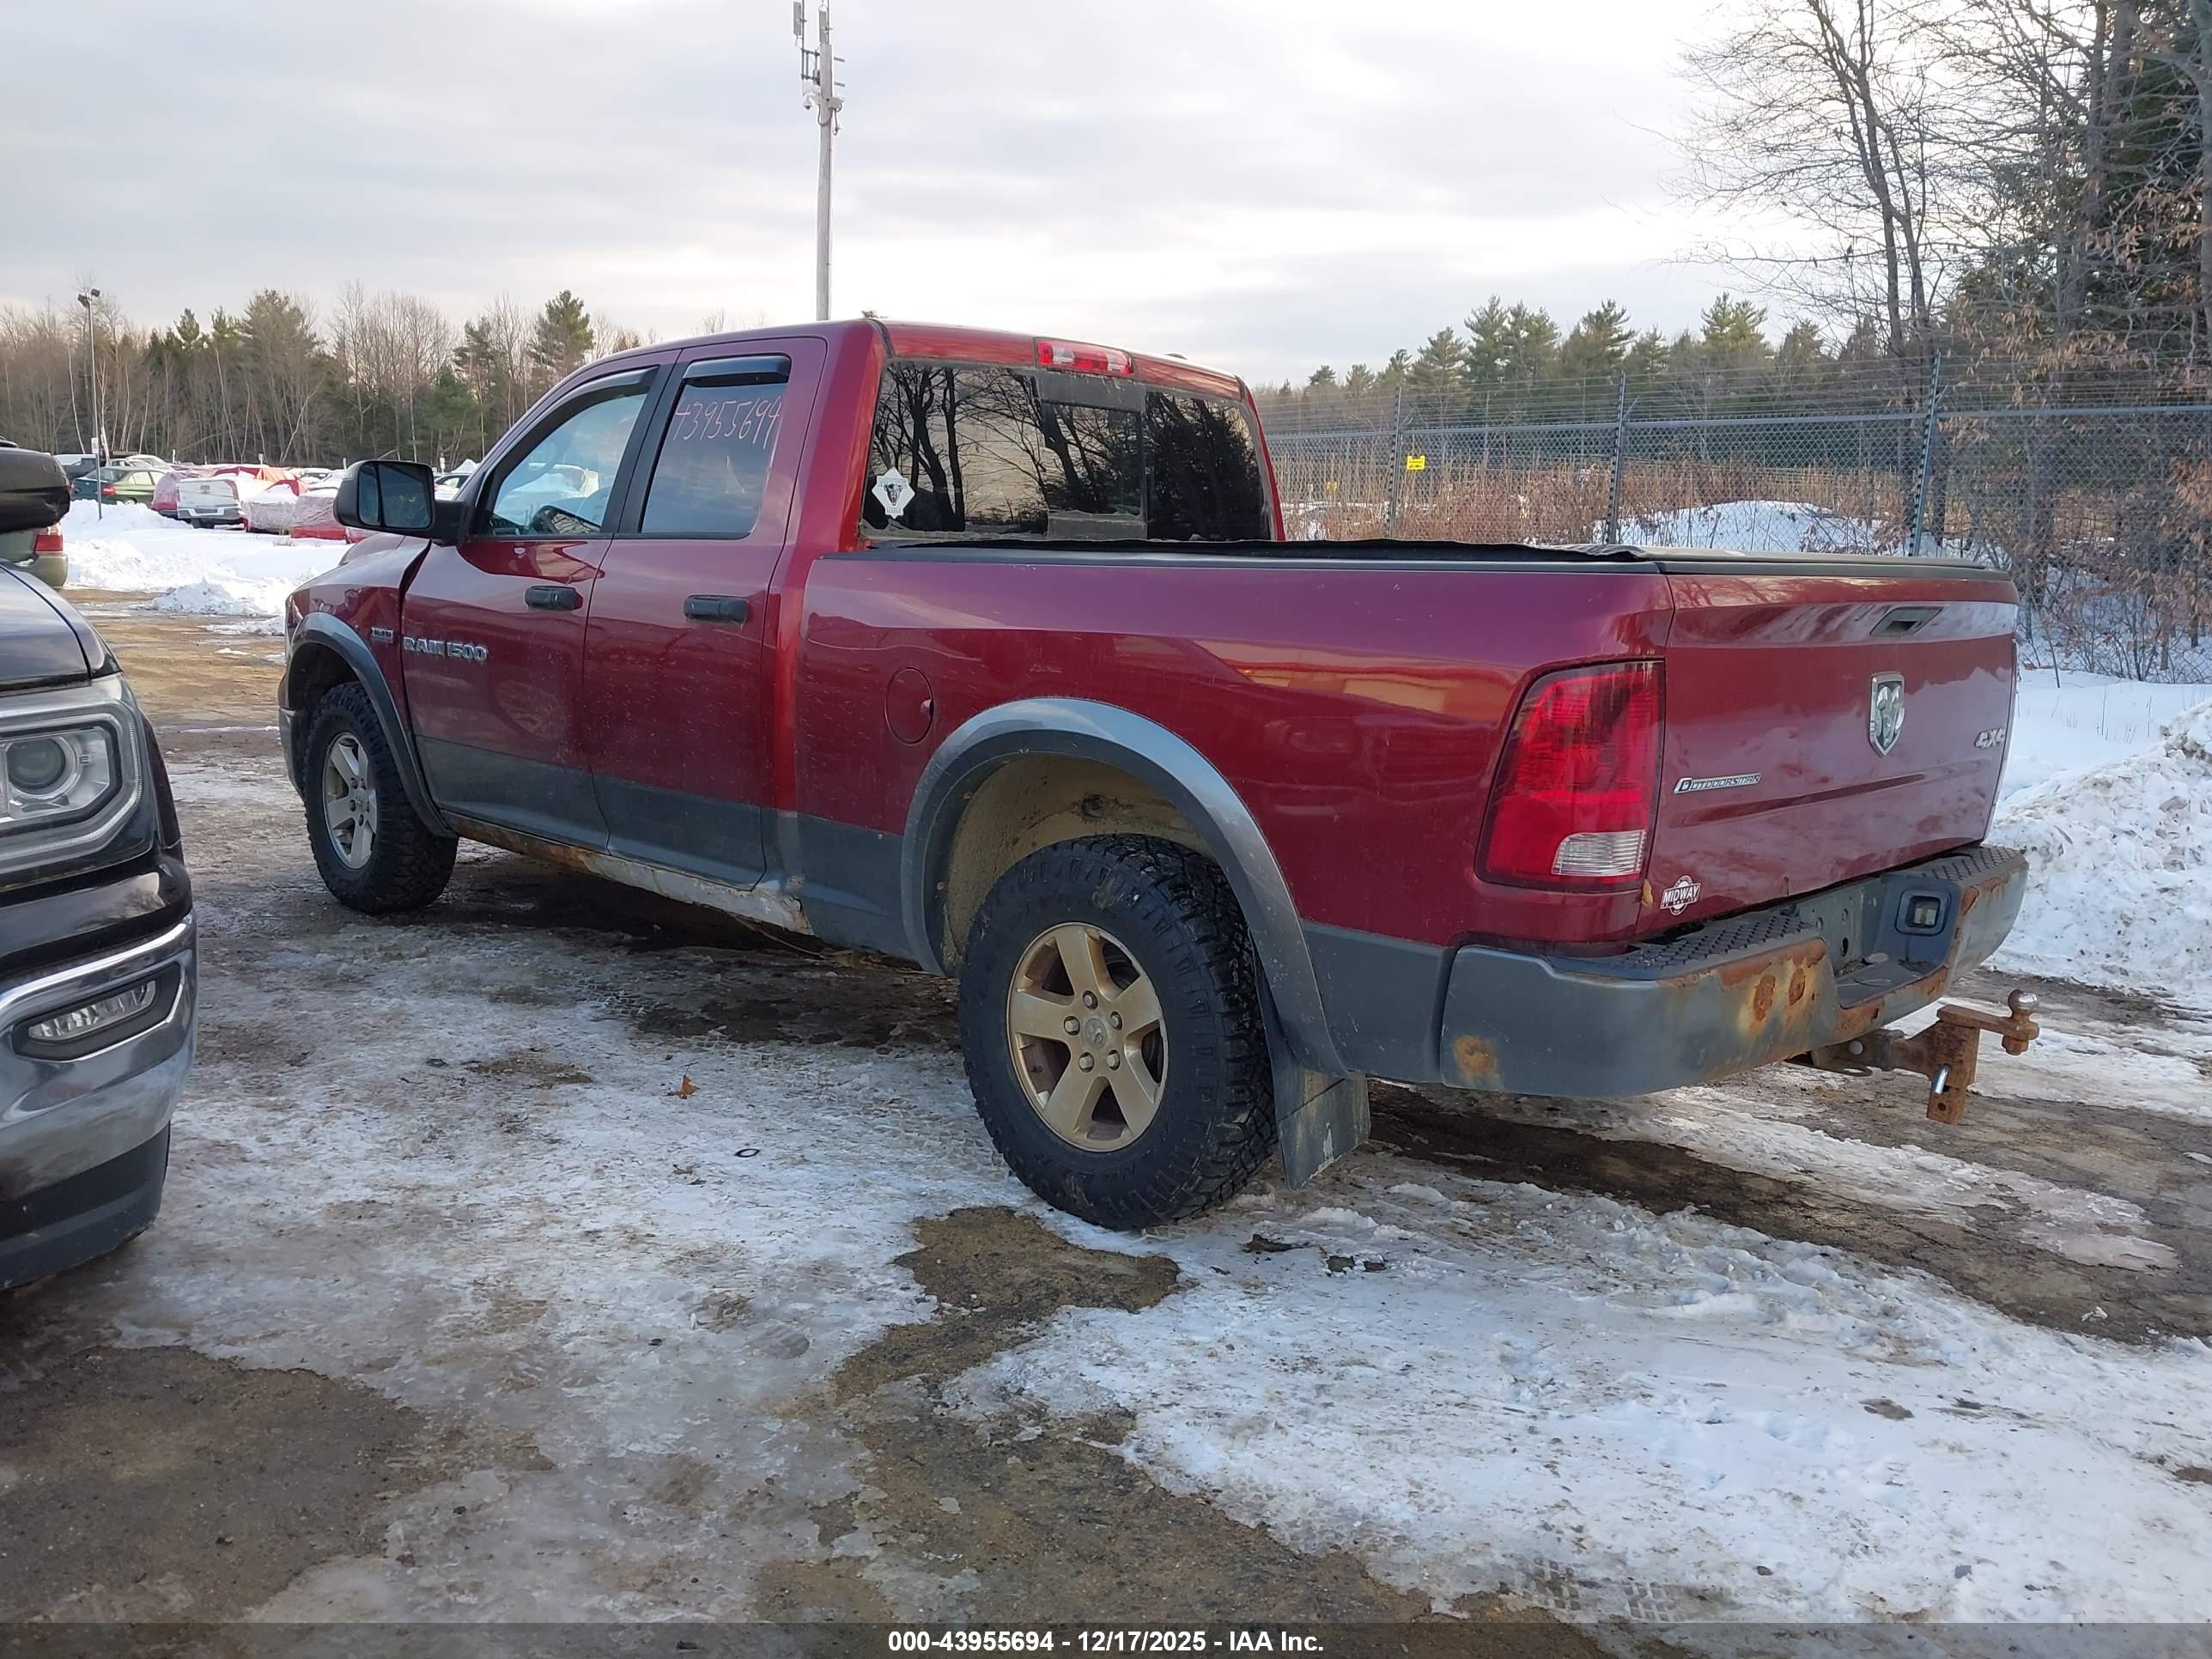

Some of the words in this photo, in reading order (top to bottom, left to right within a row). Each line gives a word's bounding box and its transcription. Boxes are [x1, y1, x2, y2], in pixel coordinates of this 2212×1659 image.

[404, 636, 445, 656] RAM
[447, 641, 489, 661] 1500
[1662, 885, 1699, 904] MIDWAY
